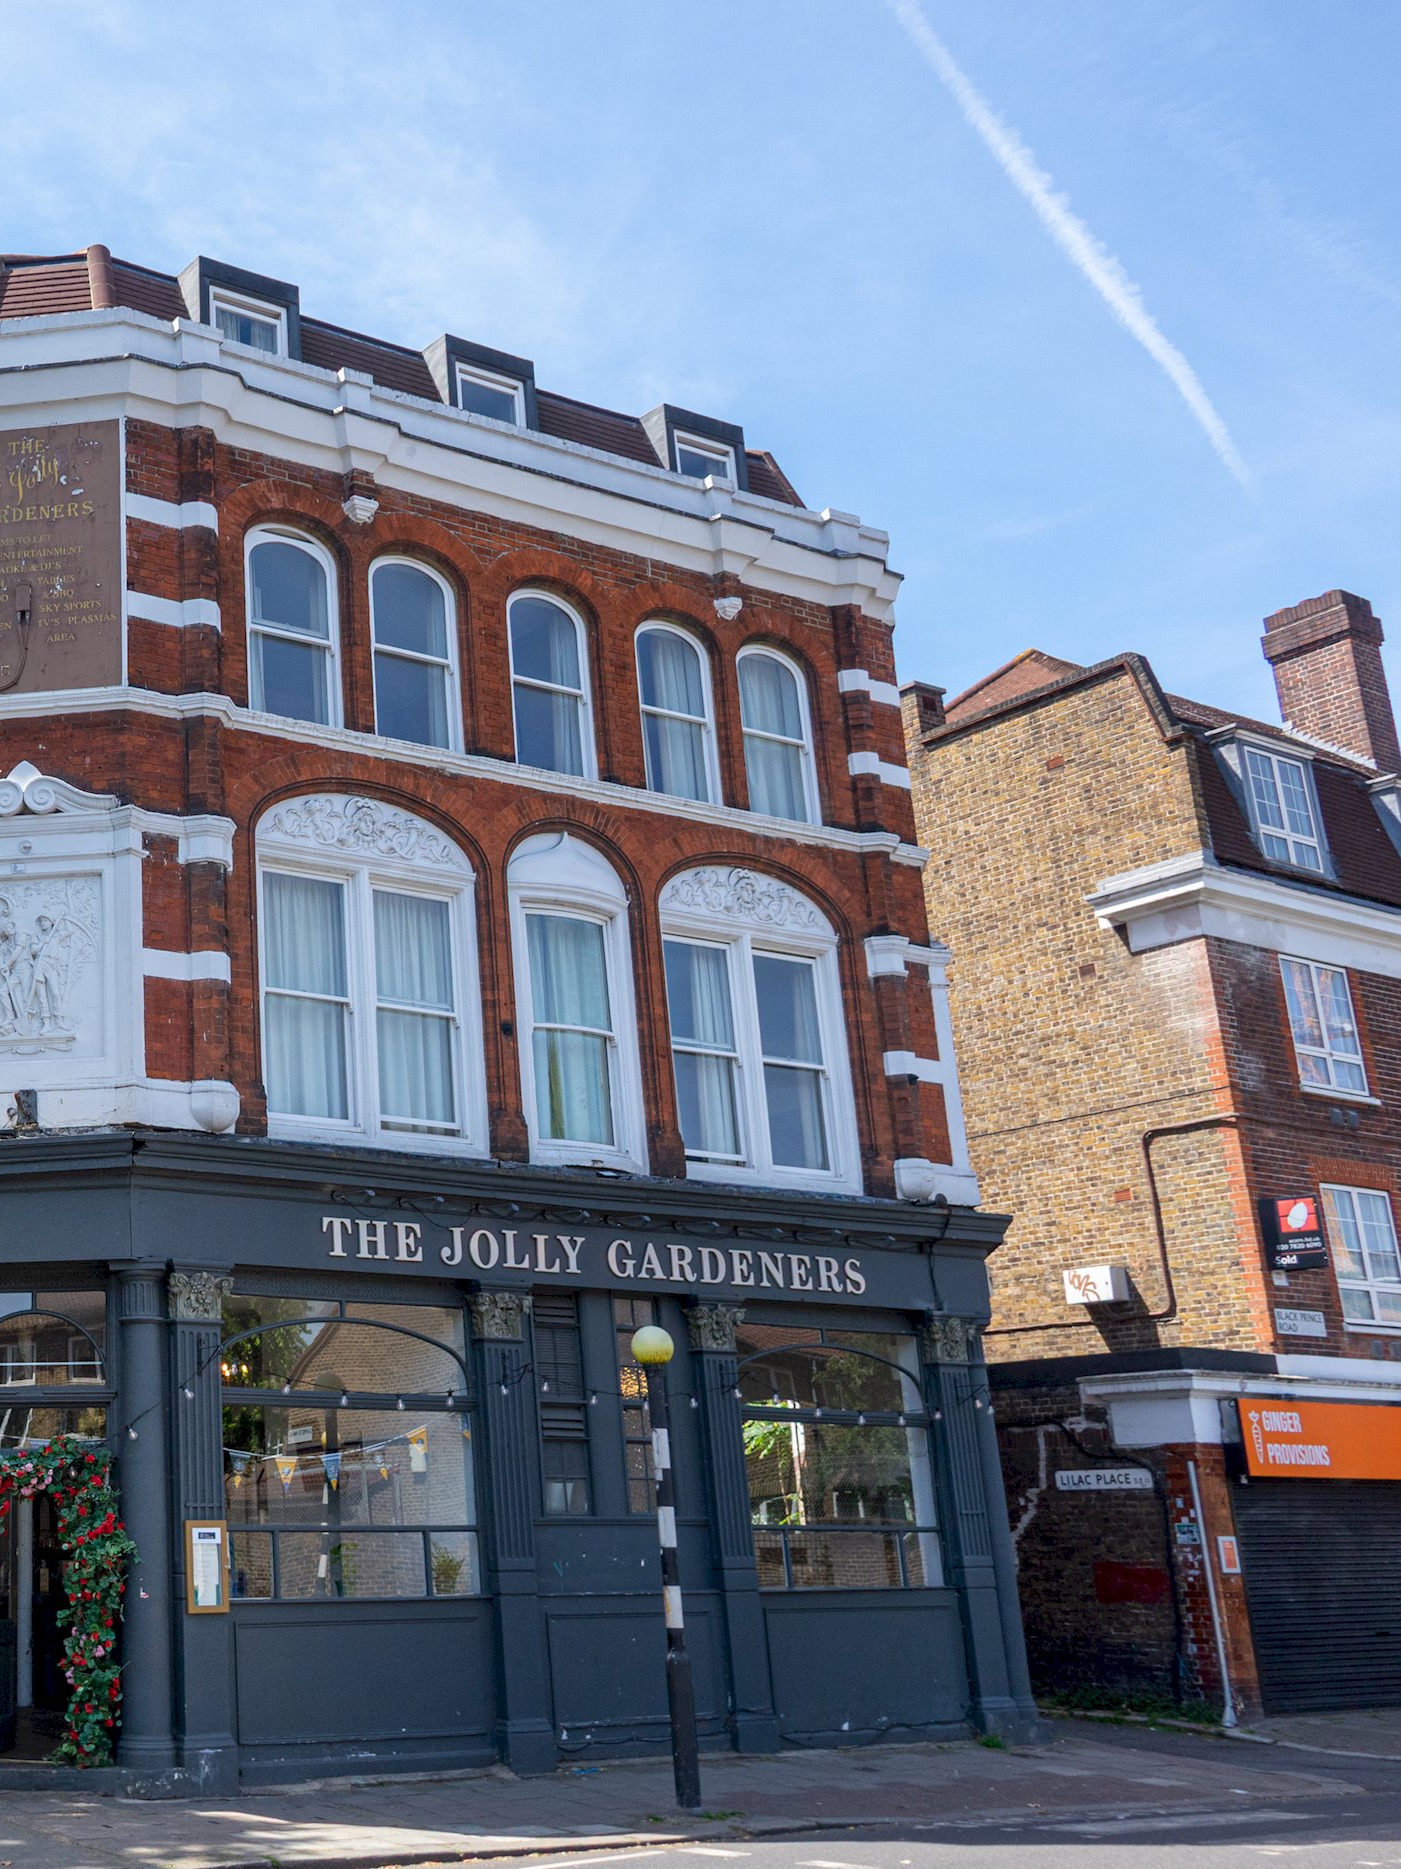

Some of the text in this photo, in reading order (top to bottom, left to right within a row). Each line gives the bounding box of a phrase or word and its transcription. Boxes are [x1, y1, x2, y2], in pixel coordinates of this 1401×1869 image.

[8, 440, 45, 456] THE
[16, 536, 30, 545] TO
[33, 534, 52, 544] LET
[30, 563, 38, 572] &
[37, 575, 75, 585] TABES
[40, 603, 61, 613] SKY
[64, 600, 102, 611] SPORTS
[68, 613, 116, 625] PLASMAS
[46, 632, 75, 642] AREA
[322, 1216, 867, 1295] THE JOLLY GARDENERS
[1275, 1254, 1298, 1265] Sold
[1277, 1310, 1323, 1324] BLACK PRINCE
[1278, 1322, 1298, 1332] ROAD
[1261, 1410, 1302, 1433] GINGER
[1266, 1443, 1331, 1466] PROVISIONS
[1060, 1474, 1091, 1486] LILAC
[1096, 1473, 1131, 1485] PLACE
